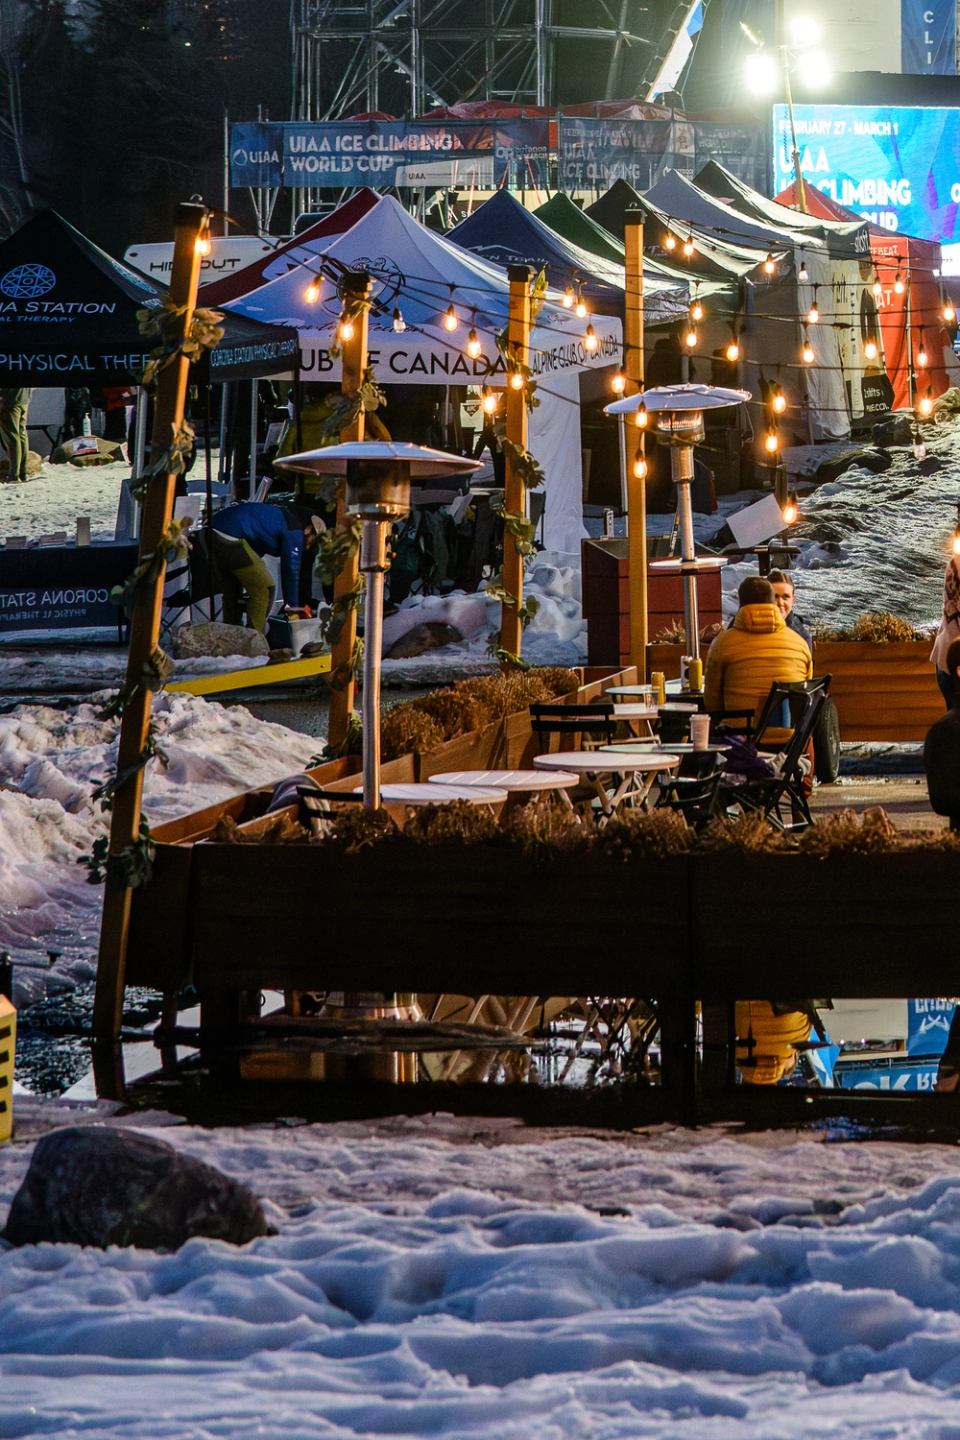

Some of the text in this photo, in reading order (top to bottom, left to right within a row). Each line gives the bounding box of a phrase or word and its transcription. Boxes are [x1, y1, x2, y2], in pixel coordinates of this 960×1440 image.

[923, 10, 935, 65] CLI
[779, 120, 831, 135] FEBRUARY
[833, 121, 846, 135] 27
[854, 121, 892, 136] MARCH
[288, 134, 453, 153] UIAA ICE CLIMBING
[249, 150, 280, 164] UIAA
[291, 154, 395, 174] WORLD CUP
[779, 146, 830, 173] UAA
[820, 178, 912, 206] CLIMBING
[869, 244, 899, 257] FFBEAT
[150, 256, 242, 273] HIOUT
[25, 301, 117, 314] STATION
[17, 315, 77, 323] THERAPY
[0, 354, 96, 371] PHYSICAL
[298, 348, 335, 372] UB
[389, 351, 509, 377] CANADA
